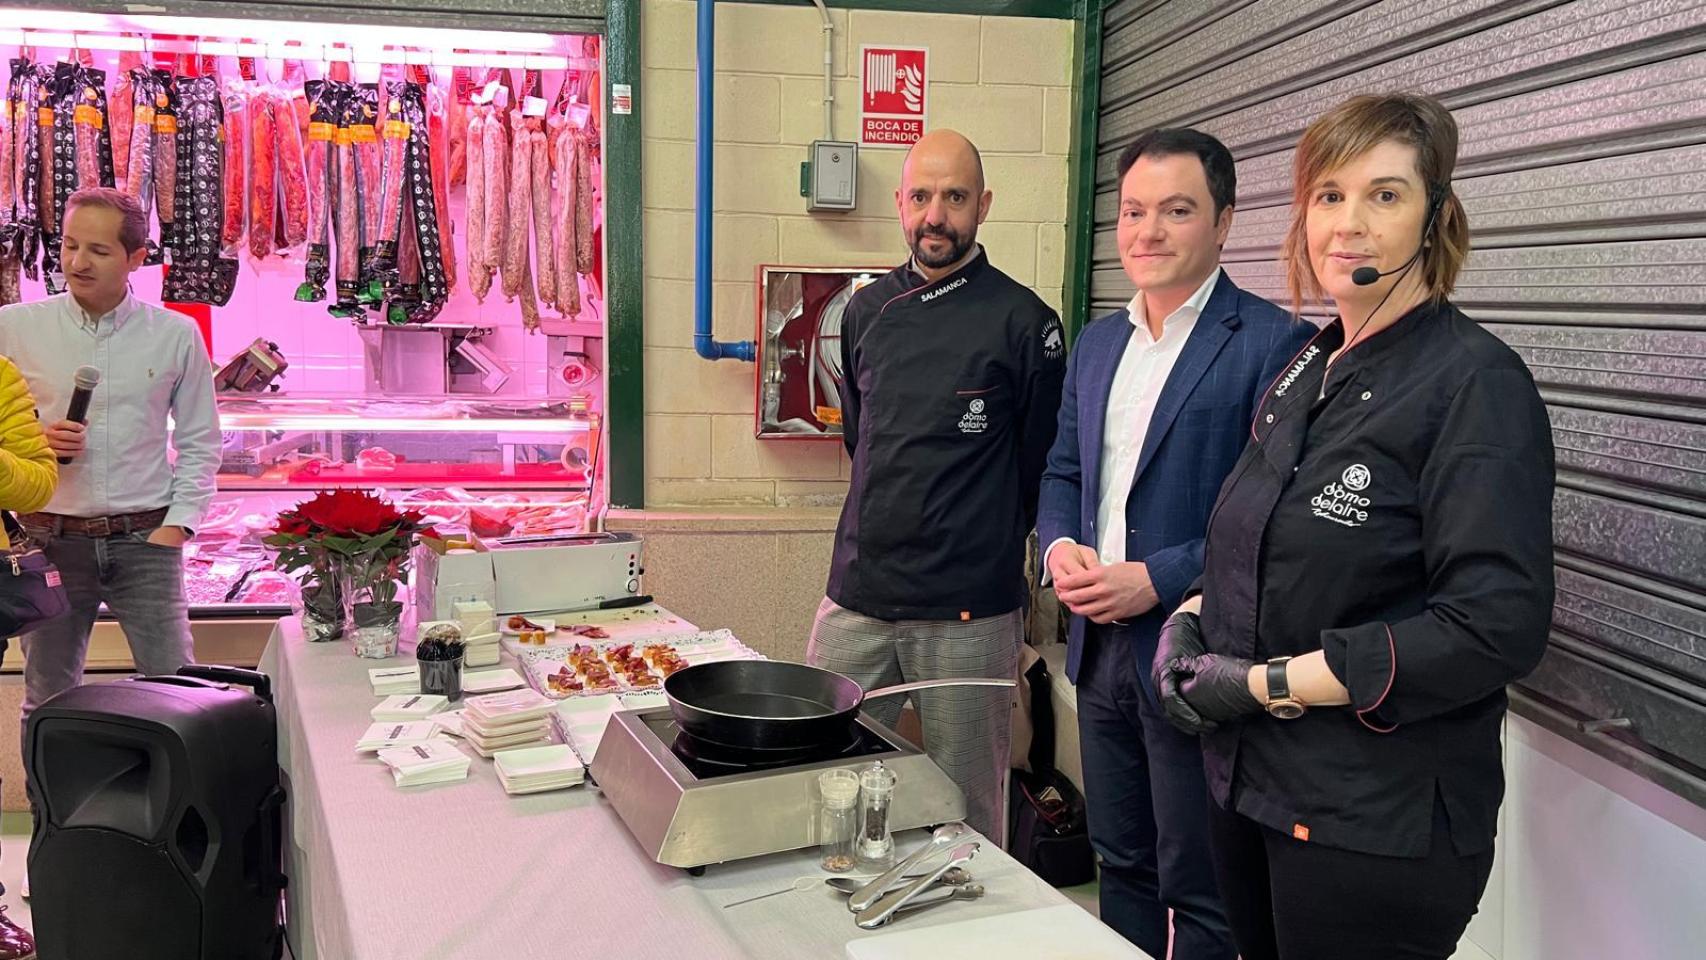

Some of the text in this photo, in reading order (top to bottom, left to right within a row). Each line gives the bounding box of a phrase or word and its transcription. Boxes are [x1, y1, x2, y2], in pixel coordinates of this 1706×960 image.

[867, 120, 919, 132] BOCA DE
[865, 131, 920, 142] INCENDIO
[920, 277, 968, 303] SALAMANCA
[1310, 493, 1369, 522] delaire
